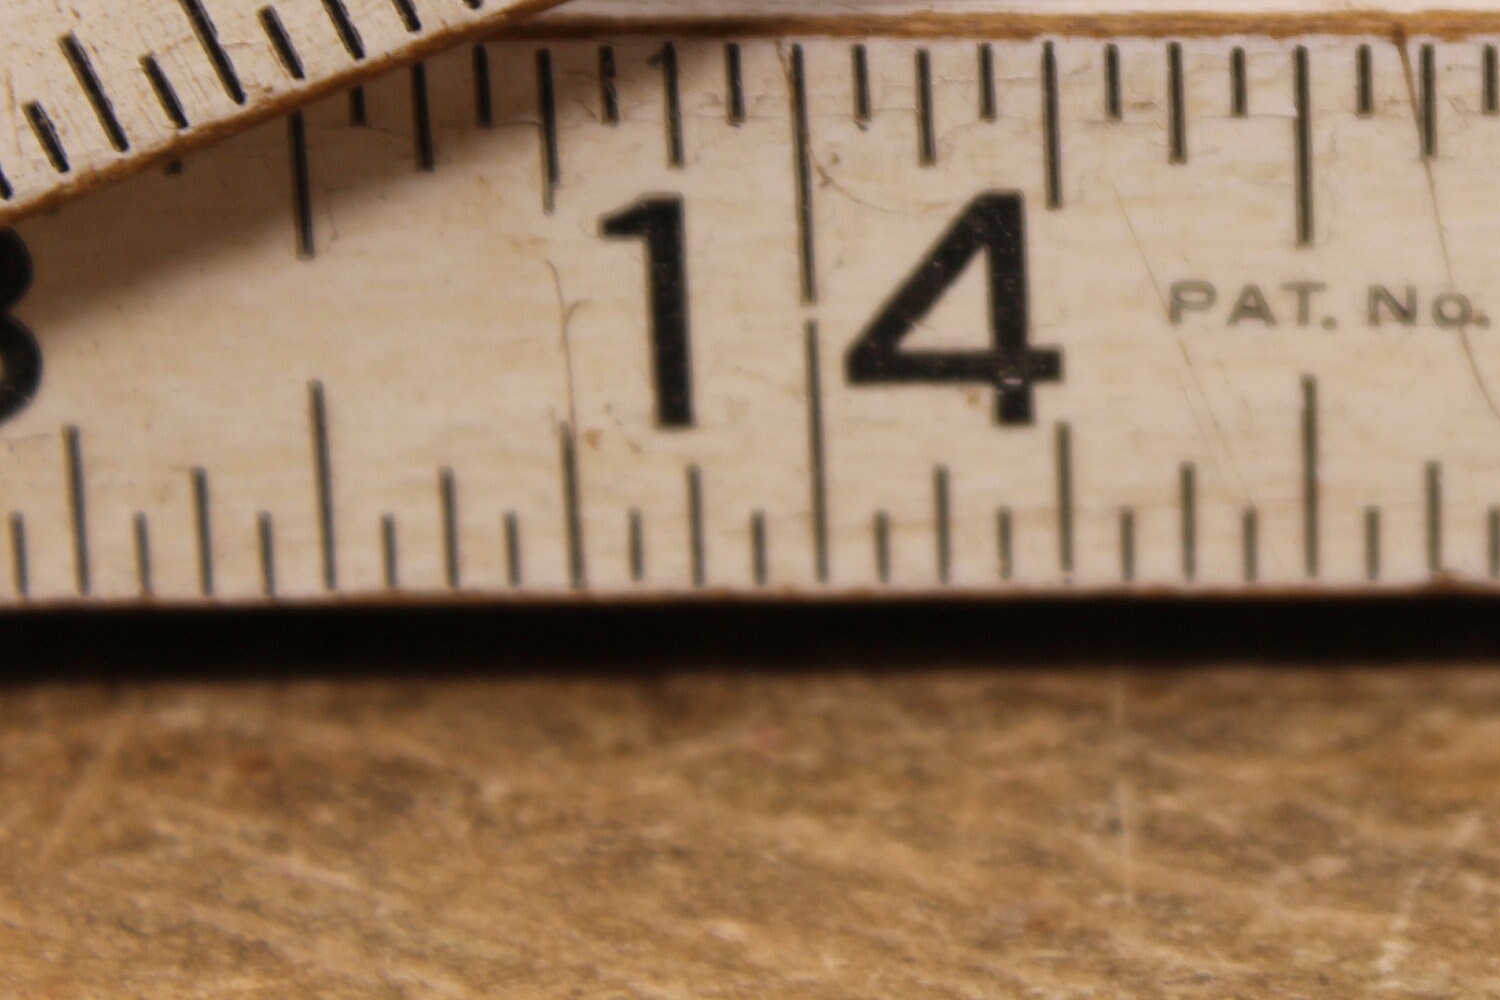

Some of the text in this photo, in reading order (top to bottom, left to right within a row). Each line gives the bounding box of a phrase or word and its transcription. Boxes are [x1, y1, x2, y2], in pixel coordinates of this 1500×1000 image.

[598, 191, 1063, 427] 14
[1168, 278, 1492, 331] PAT. No.
